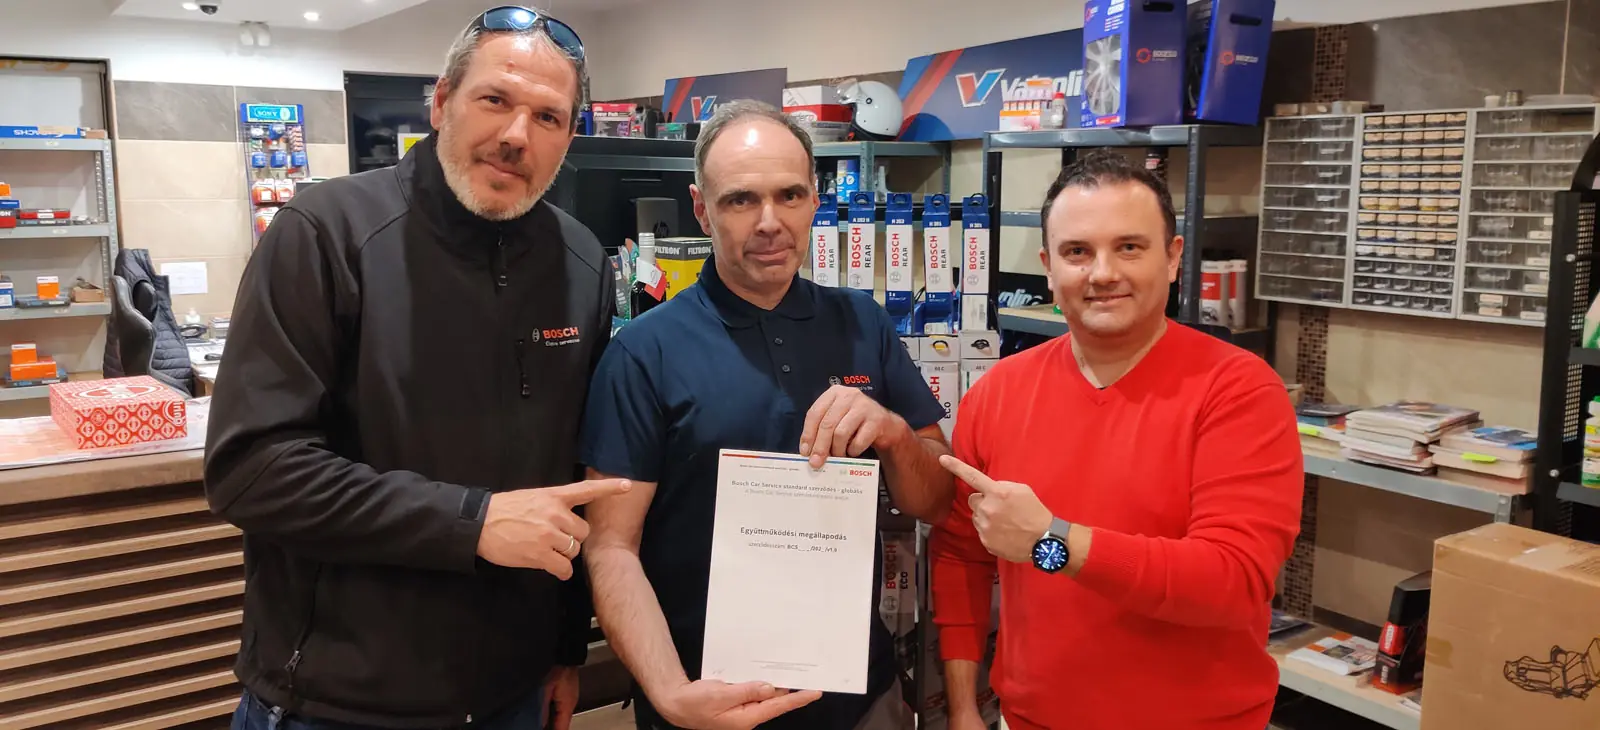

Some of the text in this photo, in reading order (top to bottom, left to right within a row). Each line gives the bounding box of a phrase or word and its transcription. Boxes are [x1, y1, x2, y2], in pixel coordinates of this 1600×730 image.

[818, 234, 826, 268] BOSCH
[852, 227, 861, 268] BOSCH
[892, 233, 900, 267] BOSCH
[930, 235, 938, 269] BOSCH
[969, 237, 977, 270] BOSCH
[543, 326, 579, 339] BOSCH
[843, 375, 870, 384] BOSCH
[849, 469, 873, 477] BOSCH
[798, 530, 847, 542] megállapodás
[885, 545, 897, 589] BOSCH
[900, 571, 908, 589] ECO
